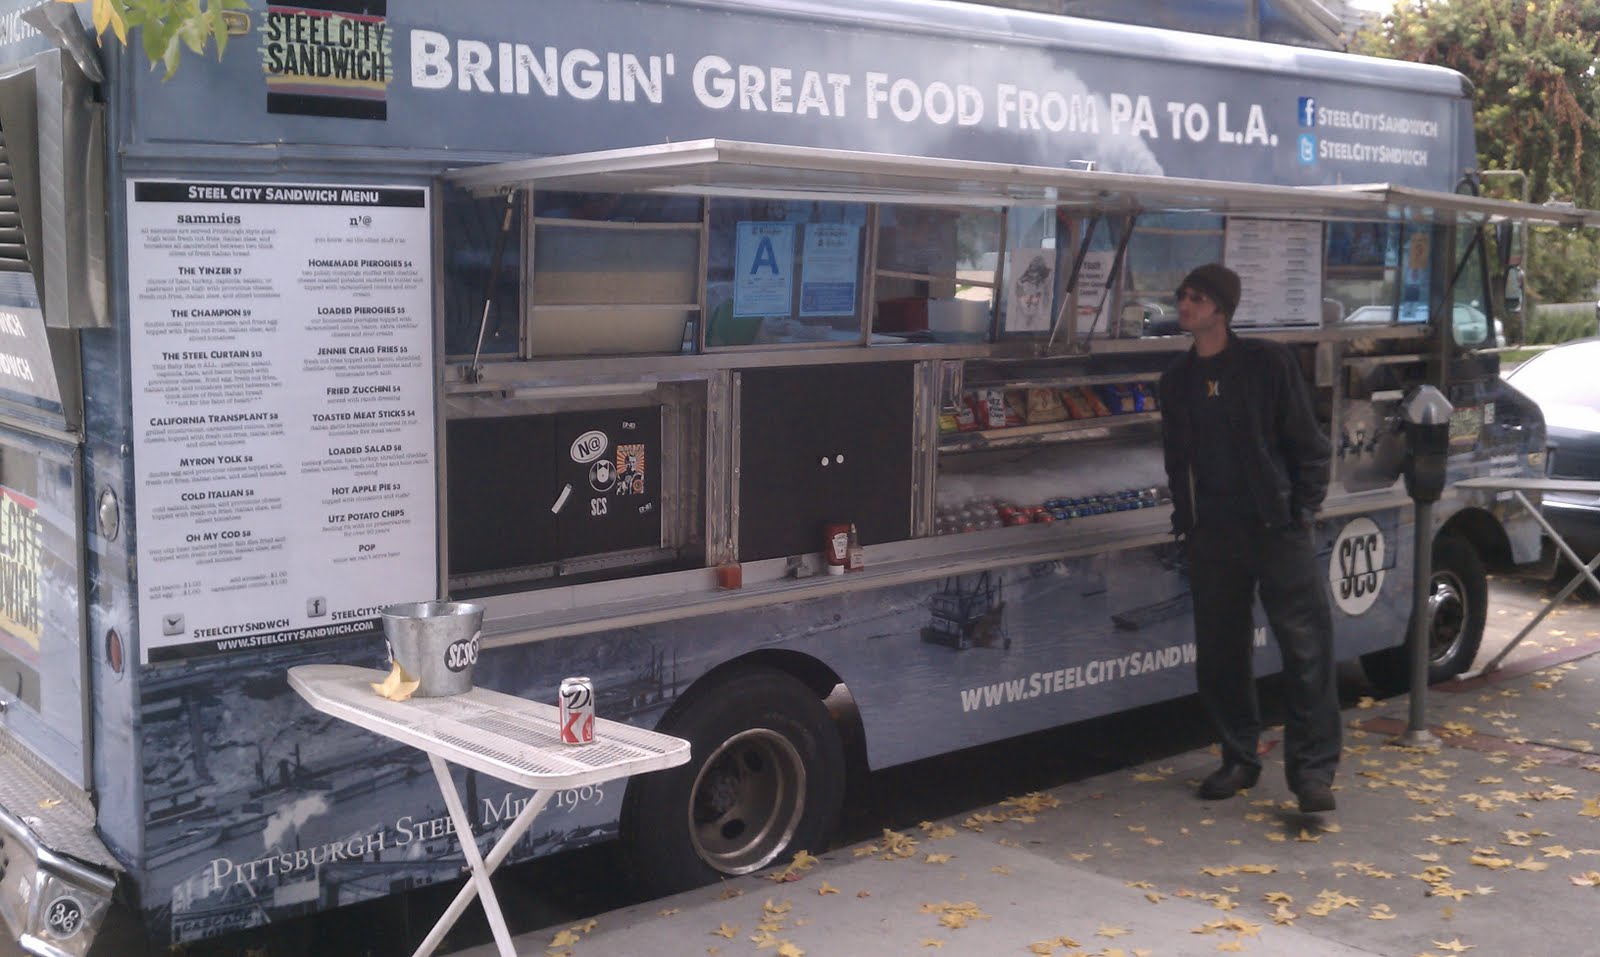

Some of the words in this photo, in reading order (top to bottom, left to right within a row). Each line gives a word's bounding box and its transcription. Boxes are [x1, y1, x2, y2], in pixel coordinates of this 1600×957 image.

[268, 11, 335, 46] STEEL
[339, 19, 386, 52] CITY
[268, 42, 385, 82] SANDWICH
[410, 29, 674, 104] BRINGIN'
[692, 55, 851, 118] GREAT
[866, 72, 984, 126] FOOD
[997, 82, 1099, 135] FROM
[1110, 92, 1159, 139] PA
[1167, 101, 1210, 142] TO
[1217, 101, 1279, 147] L.A.
[1318, 106, 1438, 137] STEELCITYSANDWICH
[188, 186, 228, 199] STEEL
[231, 187, 262, 200] CITY
[265, 188, 337, 202] SANDWICH
[341, 190, 380, 203] MENU
[177, 212, 241, 225] sammies
[750, 236, 780, 275] A
[308, 259, 359, 268] HOMEMADE
[360, 260, 403, 268] PIEROGIES
[178, 266, 196, 275] THE
[198, 266, 232, 275] YINZER
[170, 309, 189, 318] THE
[190, 308, 242, 318] CHAMPION
[317, 307, 353, 315] LOADED
[354, 306, 396, 315] PIEROGIES
[162, 352, 180, 361] THE
[182, 351, 209, 360] STEEL
[210, 350, 250, 359] CURTAIN
[317, 348, 347, 356] JENNIE
[348, 346, 375, 355] CRAIG
[377, 346, 399, 354] FRIES
[326, 387, 350, 396] FRIED
[352, 386, 392, 394] ZUCCHINI
[150, 416, 206, 427] CALIFORNIA
[208, 413, 268, 424] TRANSPLANT
[312, 413, 351, 422] TOASTED
[354, 411, 377, 420] MEAT
[378, 410, 406, 419] STICKS
[328, 447, 363, 456] LOADED
[364, 445, 393, 454] SALAD
[577, 436, 601, 458] N@
[180, 457, 215, 467] MYRON
[218, 455, 243, 464] YOLK
[181, 492, 206, 501] COLD
[208, 489, 244, 500] ITALIAN
[332, 487, 350, 496] HOT
[352, 484, 377, 495] APPLE
[378, 484, 391, 492] PIE
[590, 497, 608, 516] SCS
[328, 514, 346, 524] UTZ
[348, 512, 380, 522] POTATO
[382, 509, 405, 519] CHIPS
[186, 534, 201, 543] OH
[203, 532, 219, 542] MY
[221, 530, 241, 540] COD
[358, 544, 376, 553] POP
[1339, 533, 1377, 600] SCS
[194, 618, 290, 639] STEELCITYSNDWCH
[217, 620, 374, 651] WWW.STEELCITYSANDWICH.COM
[211, 830, 386, 890] PITTSBURGH
[395, 815, 473, 847] STEE
[556, 782, 604, 813] 1905
